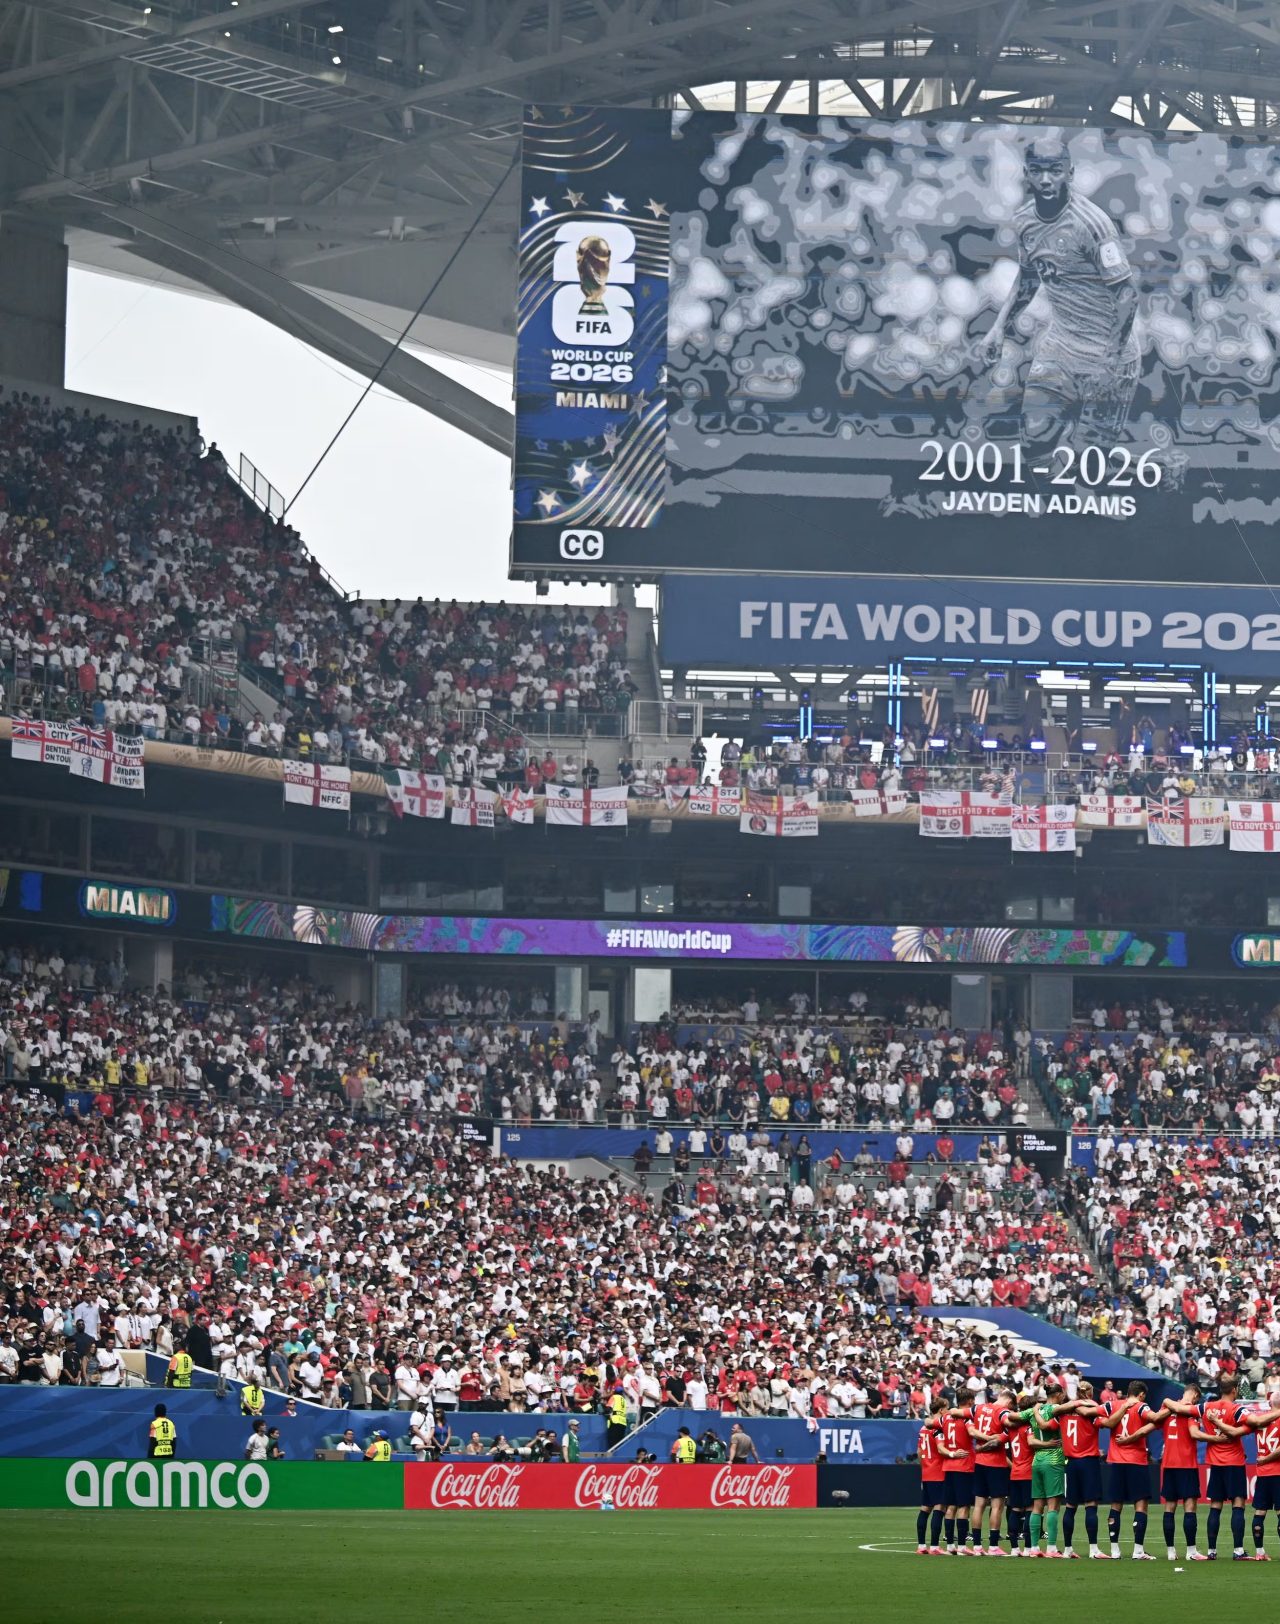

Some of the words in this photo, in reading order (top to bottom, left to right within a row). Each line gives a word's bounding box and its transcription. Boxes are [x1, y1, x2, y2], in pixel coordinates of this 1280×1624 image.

[576, 320, 612, 334] FIFA
[552, 349, 603, 362] WORLD
[605, 351, 633, 363] CUP
[550, 363, 633, 383] 2026
[556, 392, 627, 409] MIAMI
[918, 440, 1162, 488] 2001-2026
[942, 491, 1040, 512] JAYDEN
[1046, 495, 1137, 516] ADAMS
[564, 534, 599, 556] CC
[740, 601, 849, 640] FIFA
[856, 604, 1041, 645] WORLD
[1051, 609, 1152, 647] CUP
[51, 731, 69, 739] CITY
[45, 753, 55, 761] ON
[304, 777, 320, 787] TAKE
[321, 780, 330, 789] ME
[331, 782, 349, 790] HOME
[321, 794, 342, 805] NFFC
[548, 800, 587, 809] BRISTOL
[590, 801, 626, 809] ROVERS
[690, 802, 711, 812] CM2
[936, 807, 982, 816] BRENTFORD
[986, 807, 996, 816] FC
[1115, 806, 1134, 814] KENT
[1152, 817, 1181, 825] LEEDS
[1192, 816, 1224, 825] UNITED
[87, 885, 169, 920] MIAMI
[606, 929, 732, 953] #FIFAWorldCup
[506, 1133, 520, 1141] 125
[1077, 1142, 1091, 1150] 126
[948, 1422, 956, 1448] 5
[978, 1416, 993, 1436] 17
[1067, 1419, 1078, 1446] 9
[819, 1429, 864, 1454] FIFA
[1011, 1434, 1021, 1458] 6
[1257, 1426, 1280, 1454] 26
[65, 1460, 270, 1509] aramco
[430, 1463, 525, 1508] Coca-Cola
[574, 1463, 663, 1508] Coca-Cola
[711, 1463, 800, 1508] Coca-Cola
